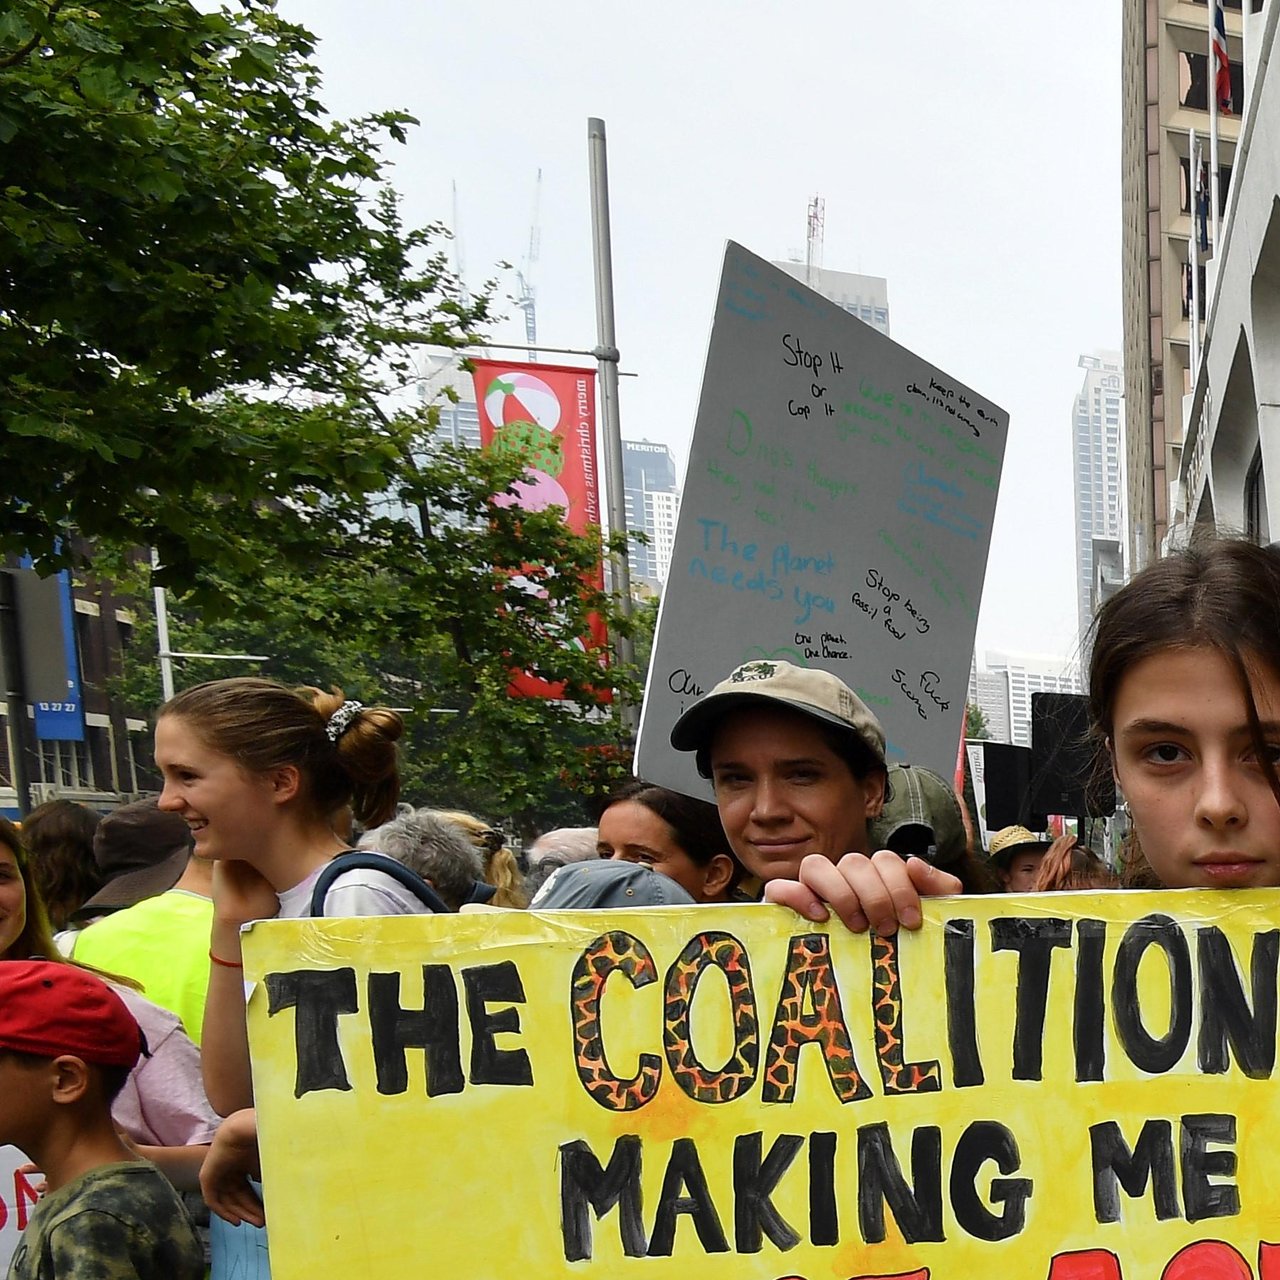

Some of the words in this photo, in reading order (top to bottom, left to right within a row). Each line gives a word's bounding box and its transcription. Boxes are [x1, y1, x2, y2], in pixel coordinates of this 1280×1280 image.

[782, 334, 822, 377] Stop
[788, 399, 810, 420] Cop
[627, 443, 667, 453] MERITON
[697, 518, 757, 562] The
[794, 586, 836, 625] you
[852, 592, 878, 620] fossil
[884, 618, 906, 640] fool
[866, 569, 900, 603] Stop
[904, 599, 930, 634] being
[883, 606, 891, 616] a
[805, 648, 820, 659] One
[39, 702, 50, 712] 13
[51, 702, 62, 712] 27
[64, 703, 76, 712] 27
[265, 960, 533, 1099] THE
[560, 1119, 1033, 1262] MAKING
[1090, 1113, 1240, 1223] ME
